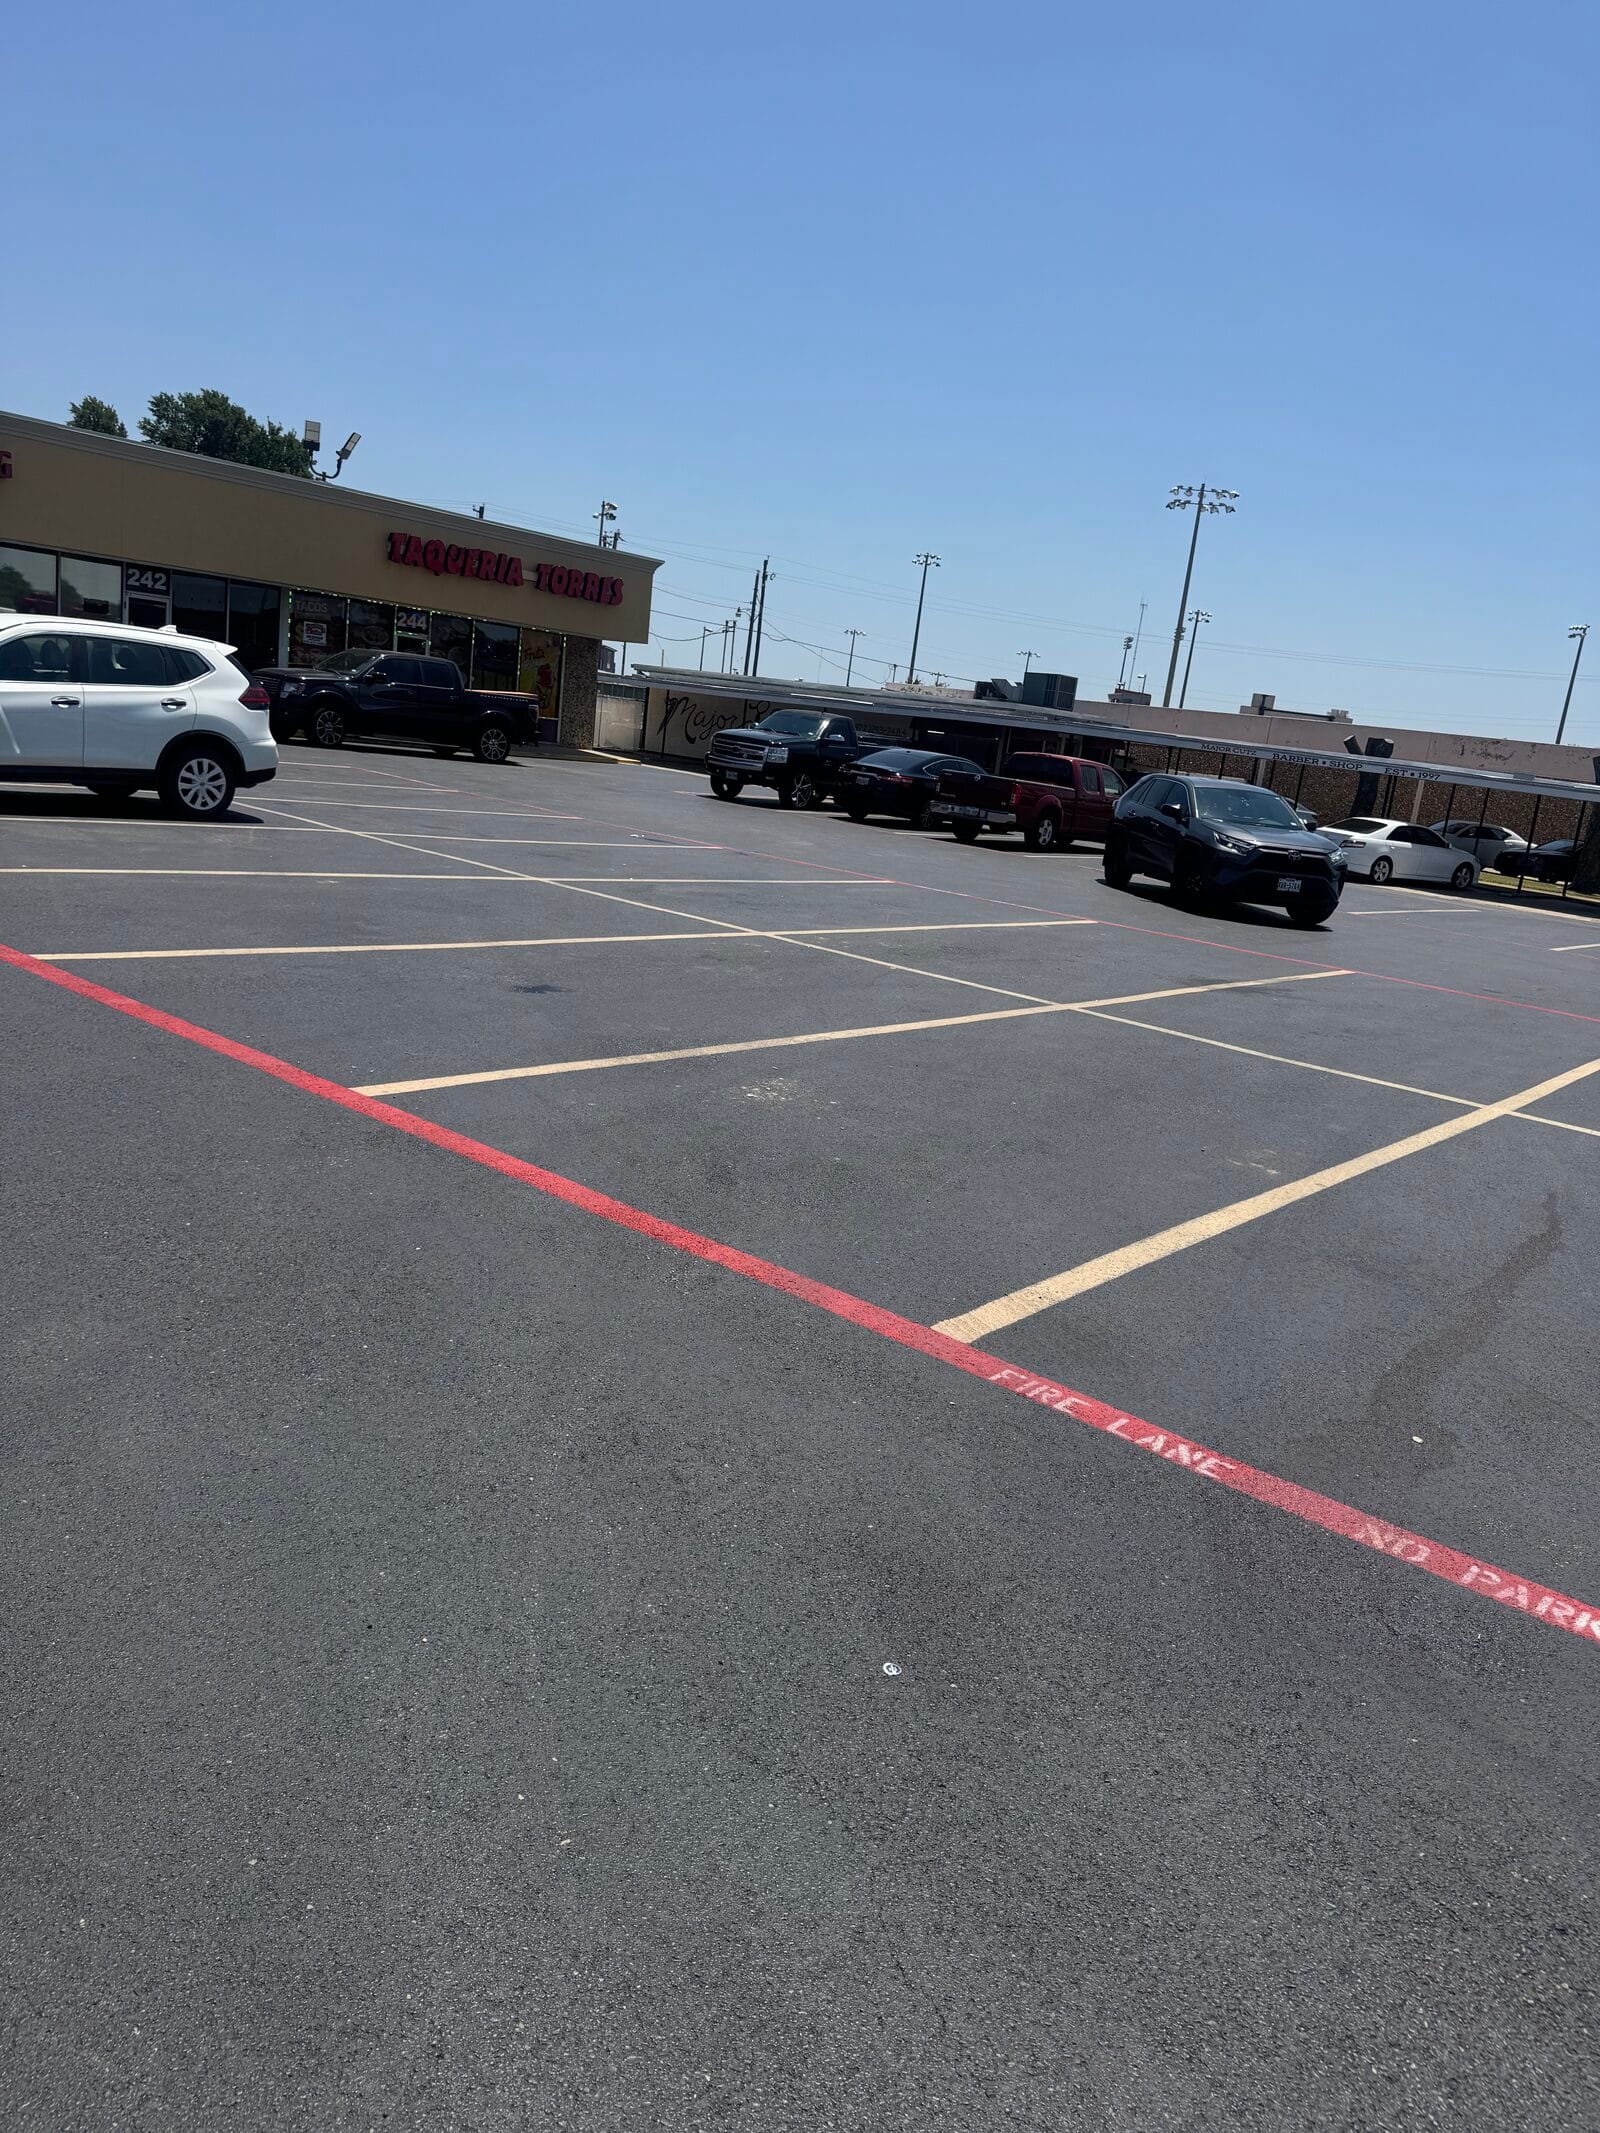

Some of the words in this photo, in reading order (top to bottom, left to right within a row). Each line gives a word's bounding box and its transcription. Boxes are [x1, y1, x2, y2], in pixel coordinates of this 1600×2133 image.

[127, 568, 168, 591] 242
[388, 532, 524, 587] TAQUERIA
[536, 563, 624, 606] TORRES
[295, 600, 328, 613] TACOS
[397, 611, 429, 631] 244
[1200, 743, 1230, 753] MAJOR
[1231, 748, 1257, 757] CUTZ
[1272, 753, 1319, 765] BARBER
[1328, 760, 1363, 771] SHOP
[1383, 767, 1408, 777] EST
[1417, 771, 1441, 781] 1997
[988, 1368, 1091, 1415] FIRE
[1106, 1417, 1237, 1480] LANE
[1354, 1522, 1432, 1565] NO
